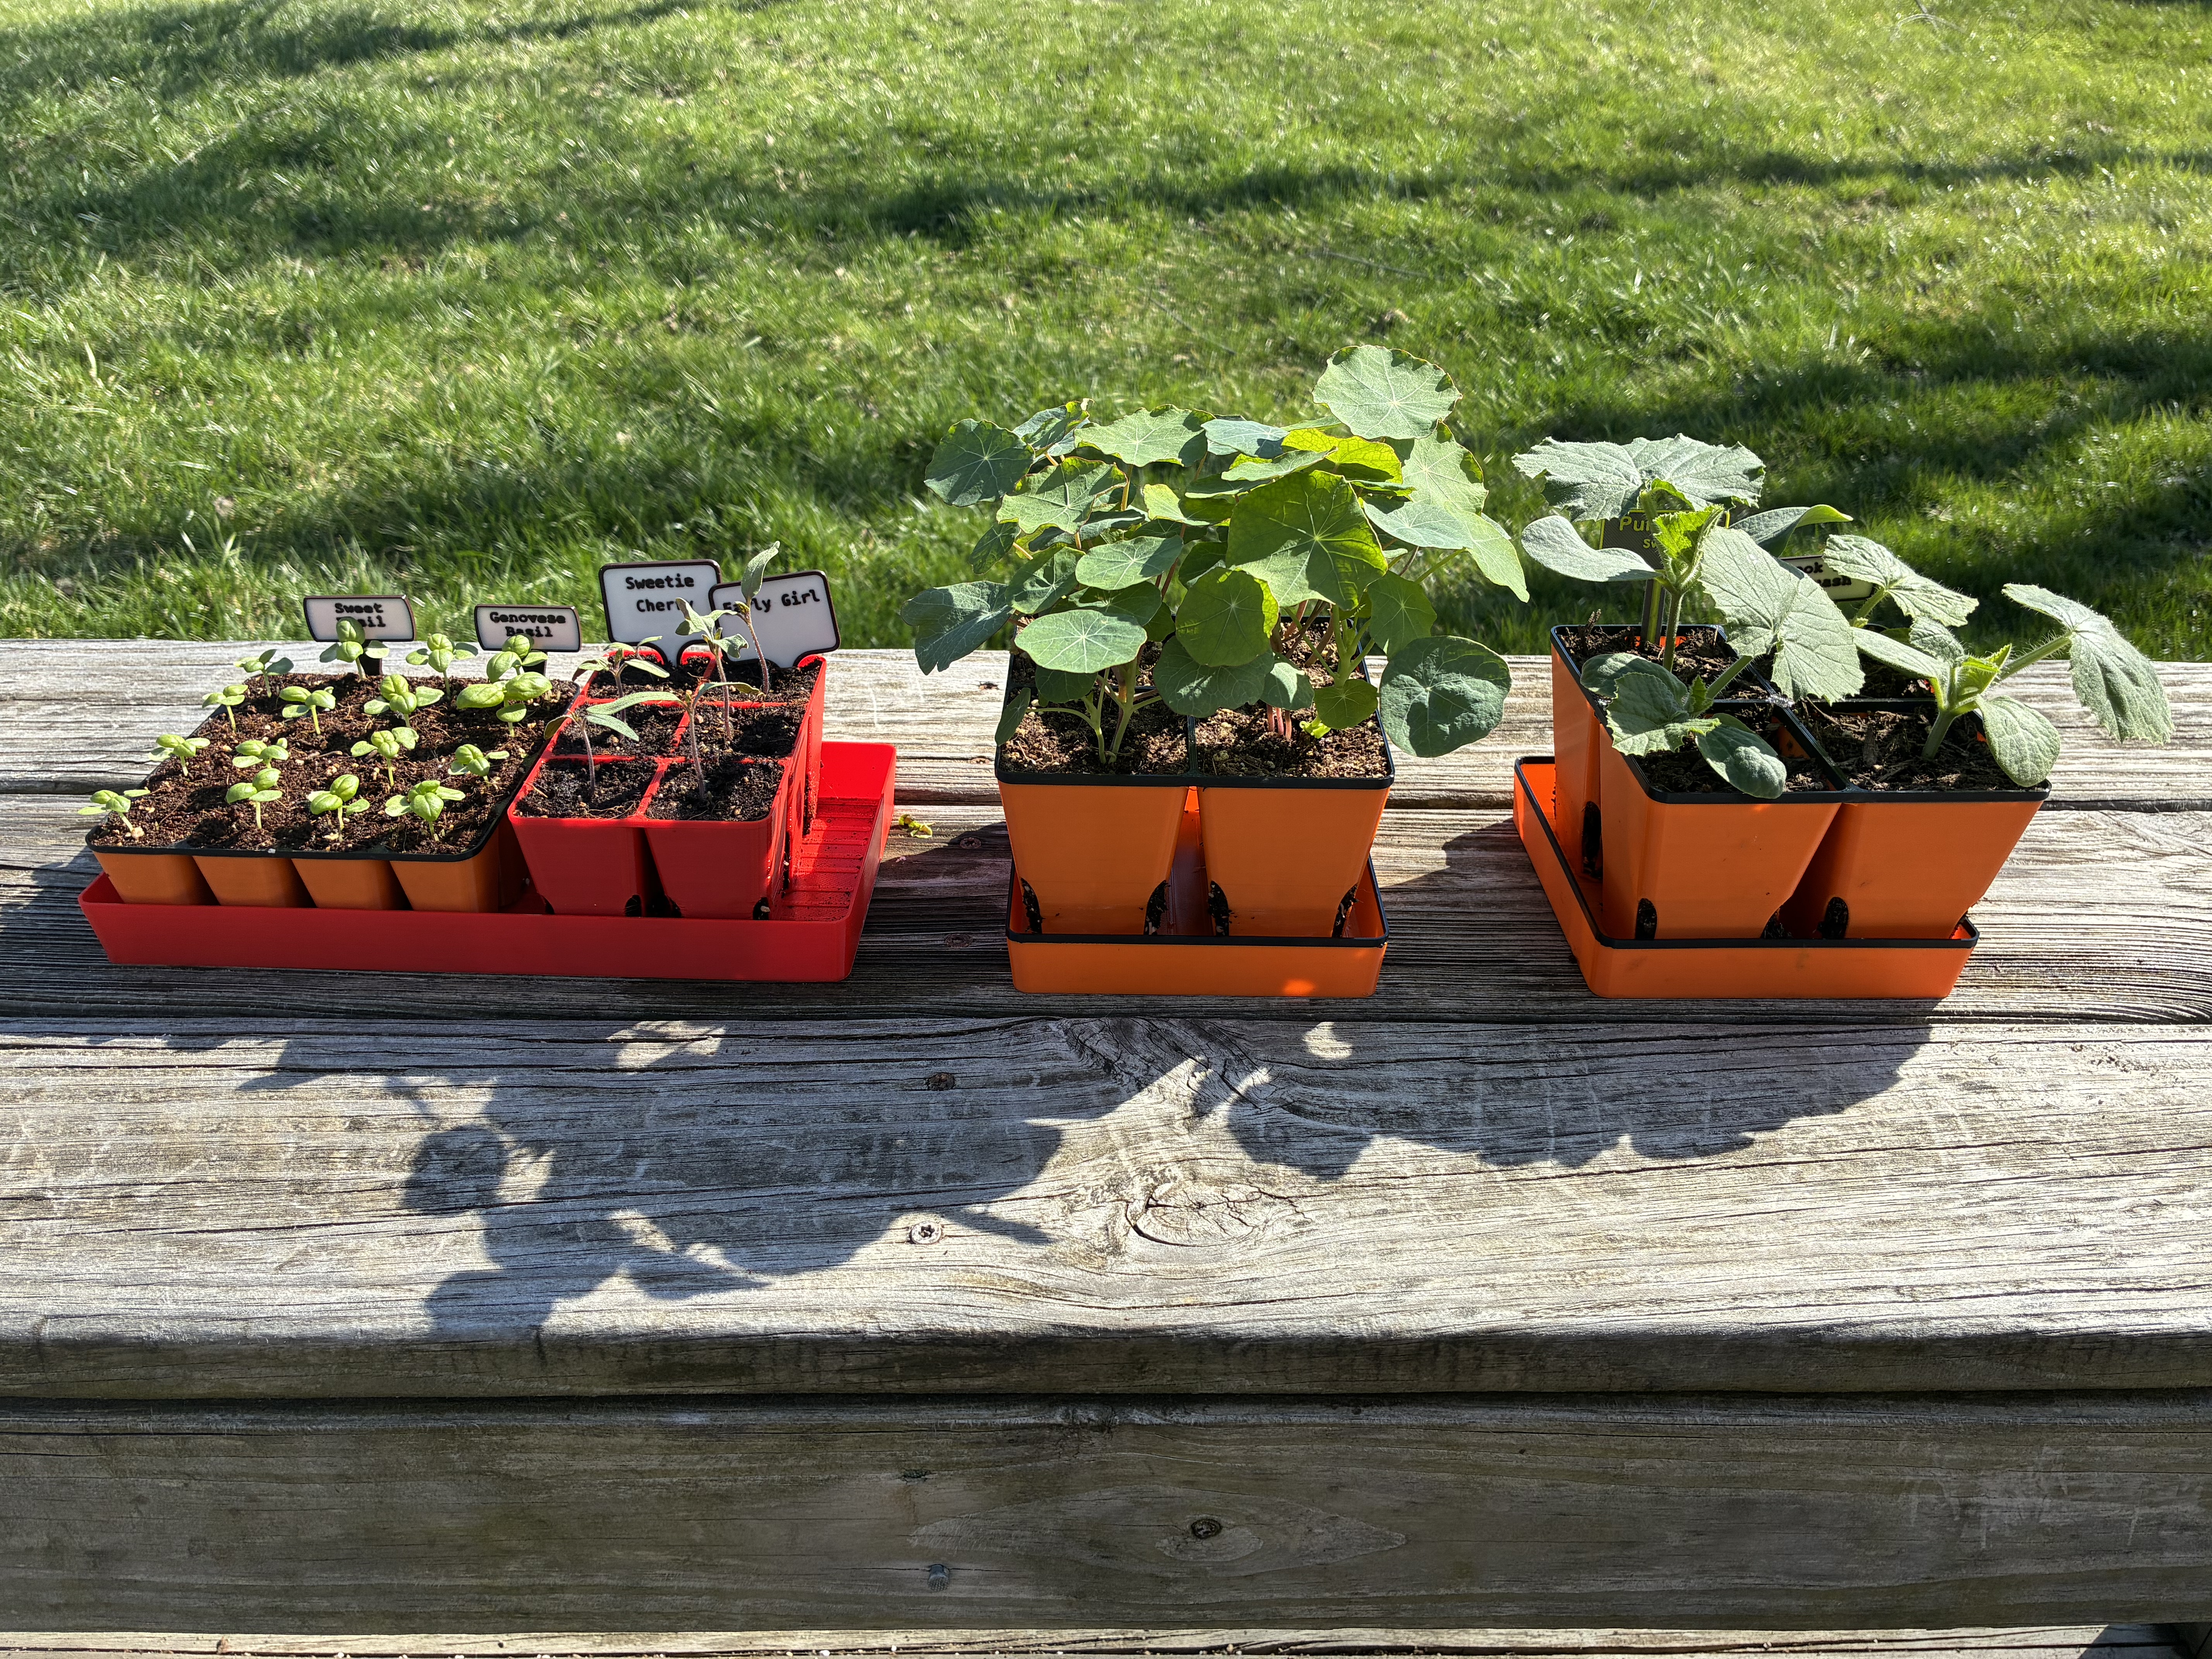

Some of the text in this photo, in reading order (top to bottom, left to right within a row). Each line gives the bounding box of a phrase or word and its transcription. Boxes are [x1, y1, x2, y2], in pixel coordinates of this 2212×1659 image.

[625, 573, 694, 589] Sweetie
[335, 603, 384, 613] Sweet
[723, 589, 820, 613] Ealy Girl
[489, 611, 566, 623] Genovese
